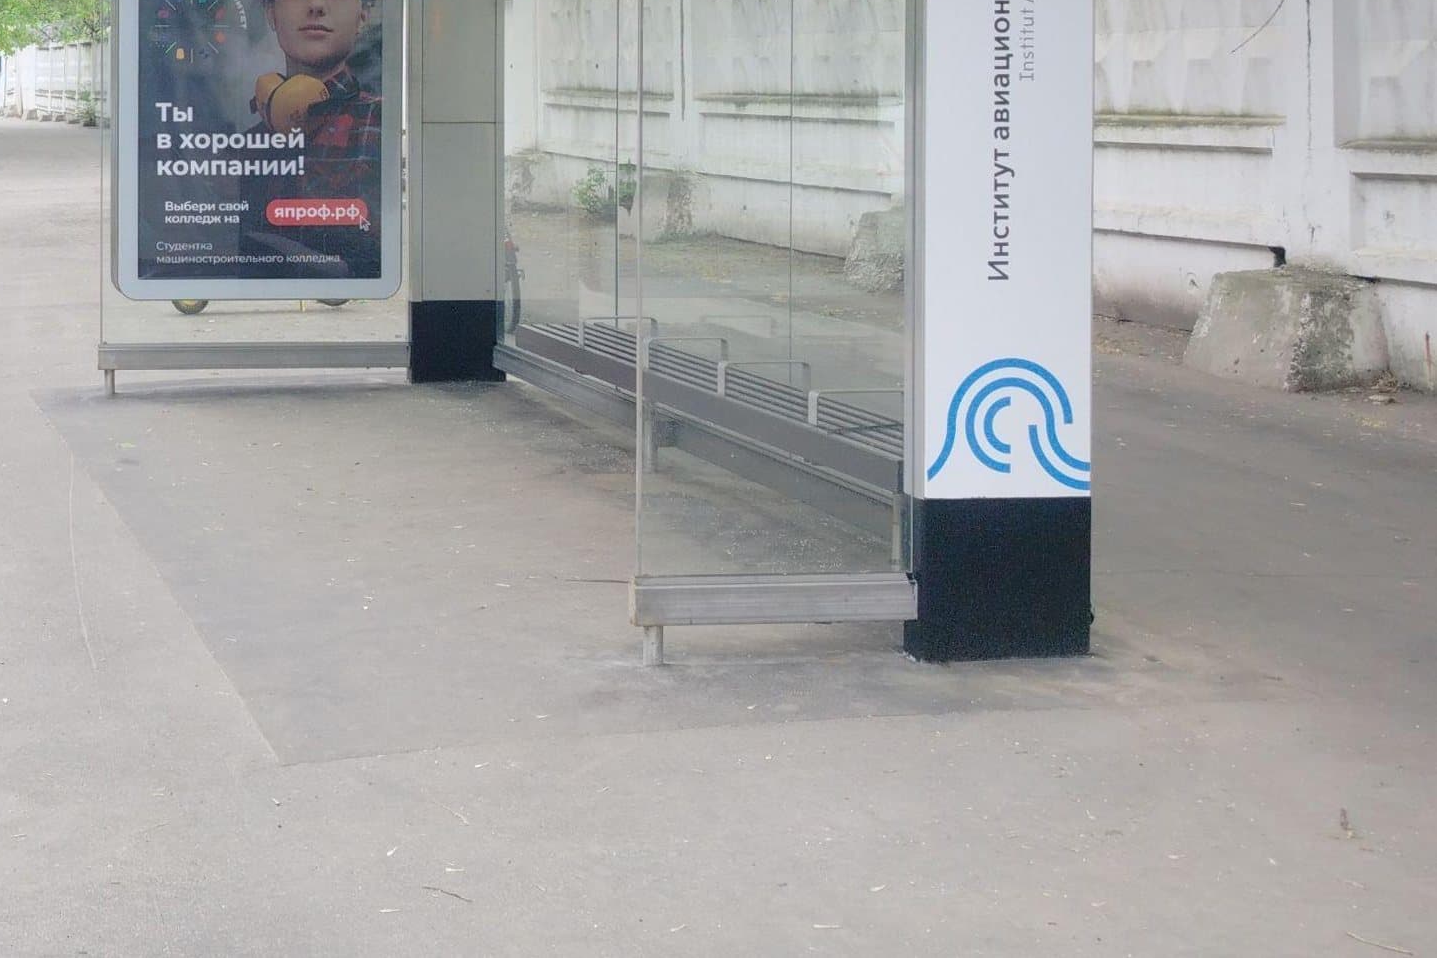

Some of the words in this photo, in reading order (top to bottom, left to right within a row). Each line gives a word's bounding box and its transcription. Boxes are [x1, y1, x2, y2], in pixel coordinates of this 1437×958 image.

[1018, 8, 1035, 82] Institut
[156, 102, 193, 123] Ты
[157, 134, 171, 149] в
[180, 128, 305, 154] хорошей
[157, 156, 305, 176] компании!
[165, 201, 215, 213] Выбери
[218, 201, 249, 211] свой
[274, 204, 360, 220] япроф.рф
[987, 149, 1015, 282] Институт
[165, 215, 221, 225] колледж
[223, 215, 239, 223] на
[156, 241, 213, 252] Студентка
[156, 254, 284, 265] машиностроительного
[287, 254, 340, 264] колледжа
